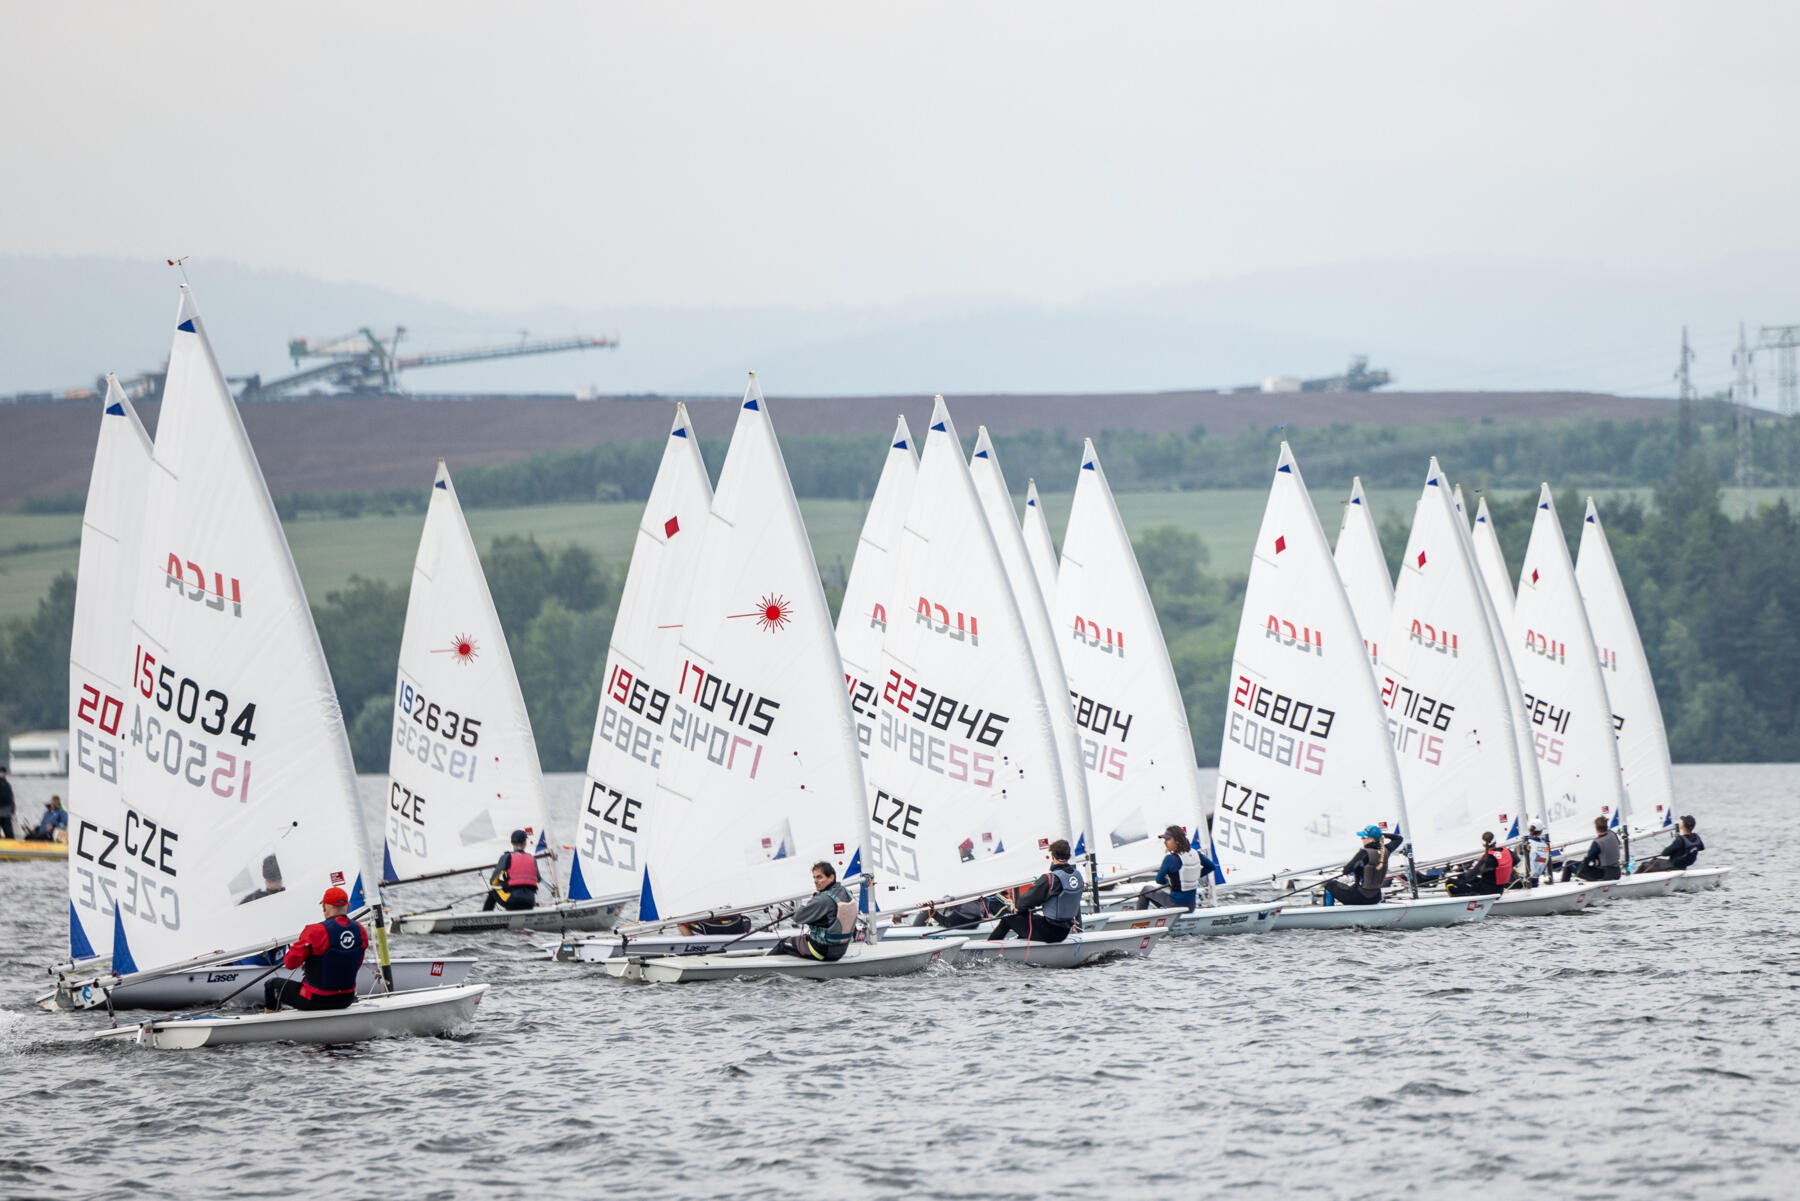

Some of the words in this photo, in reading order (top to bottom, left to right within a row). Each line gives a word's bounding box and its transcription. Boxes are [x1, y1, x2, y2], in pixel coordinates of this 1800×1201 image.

[77, 683, 125, 739] 20
[133, 644, 257, 747] 155034
[398, 679, 481, 748] 192635
[607, 664, 671, 726] 1969
[679, 660, 781, 736] 170415
[883, 669, 1010, 748] 223846
[1234, 675, 1335, 739] 216803
[1380, 677, 1455, 732] 217126
[391, 781, 425, 826] CZE
[587, 781, 642, 833] CZE
[872, 789, 923, 840] CZE
[1221, 779, 1270, 823] CZE
[125, 809, 178, 877] CZE
[207, 971, 239, 983] Laser
